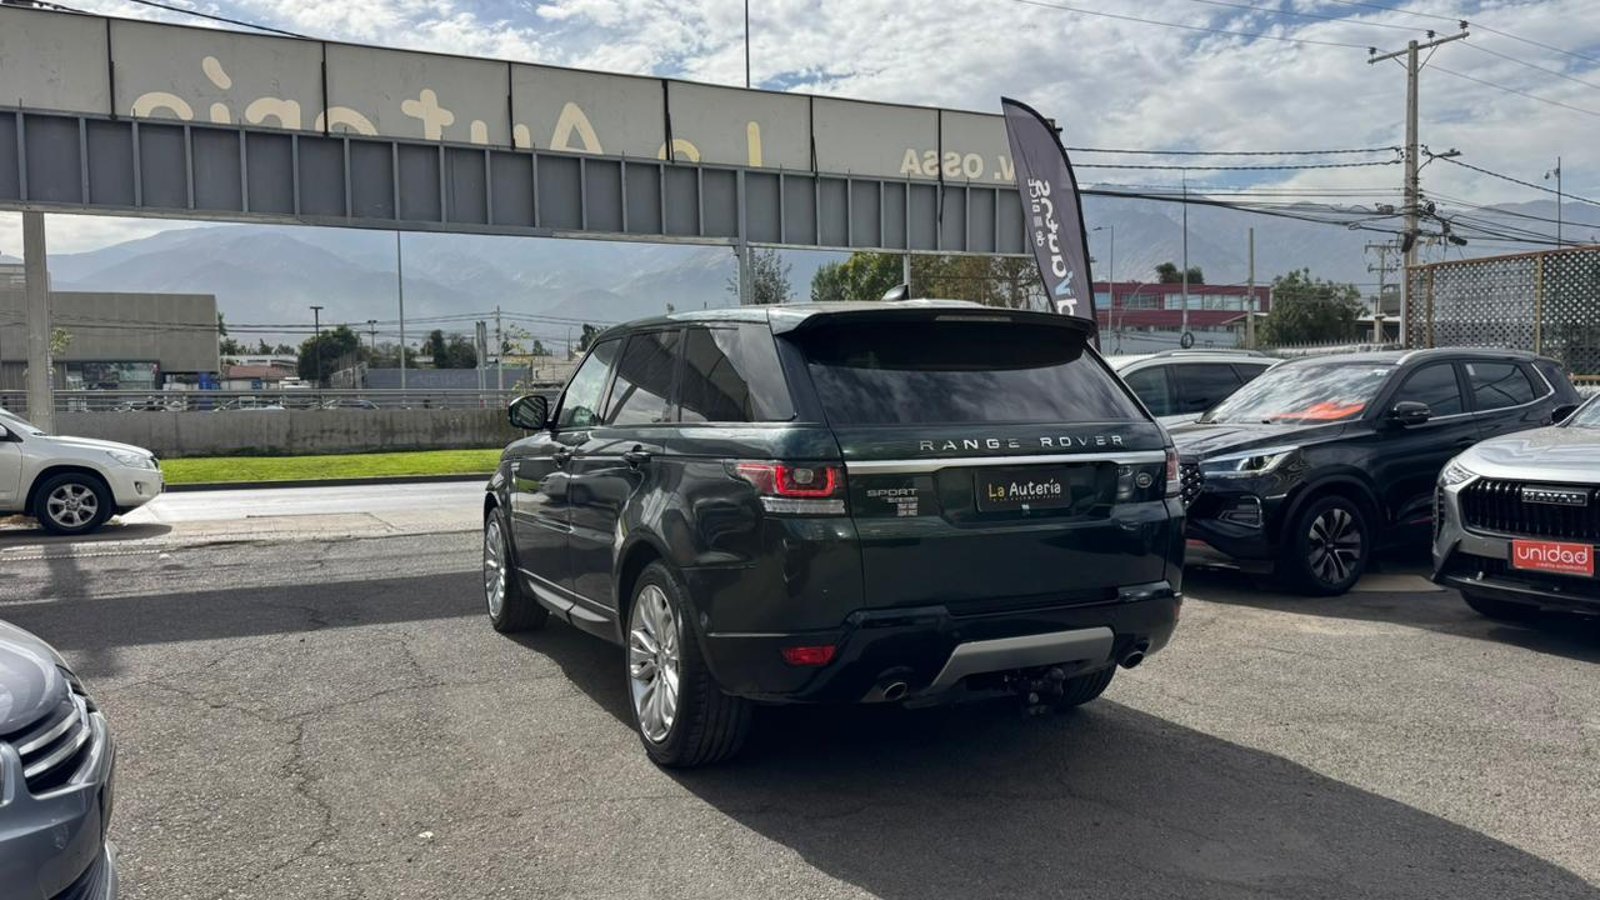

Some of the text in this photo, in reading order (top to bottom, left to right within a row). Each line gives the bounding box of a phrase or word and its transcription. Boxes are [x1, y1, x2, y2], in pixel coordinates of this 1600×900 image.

[920, 435, 1124, 451] RANGE ROVER
[866, 488, 919, 497] SPORT
[988, 478, 1061, 498] La Autería
[1517, 544, 1588, 565] unidad
